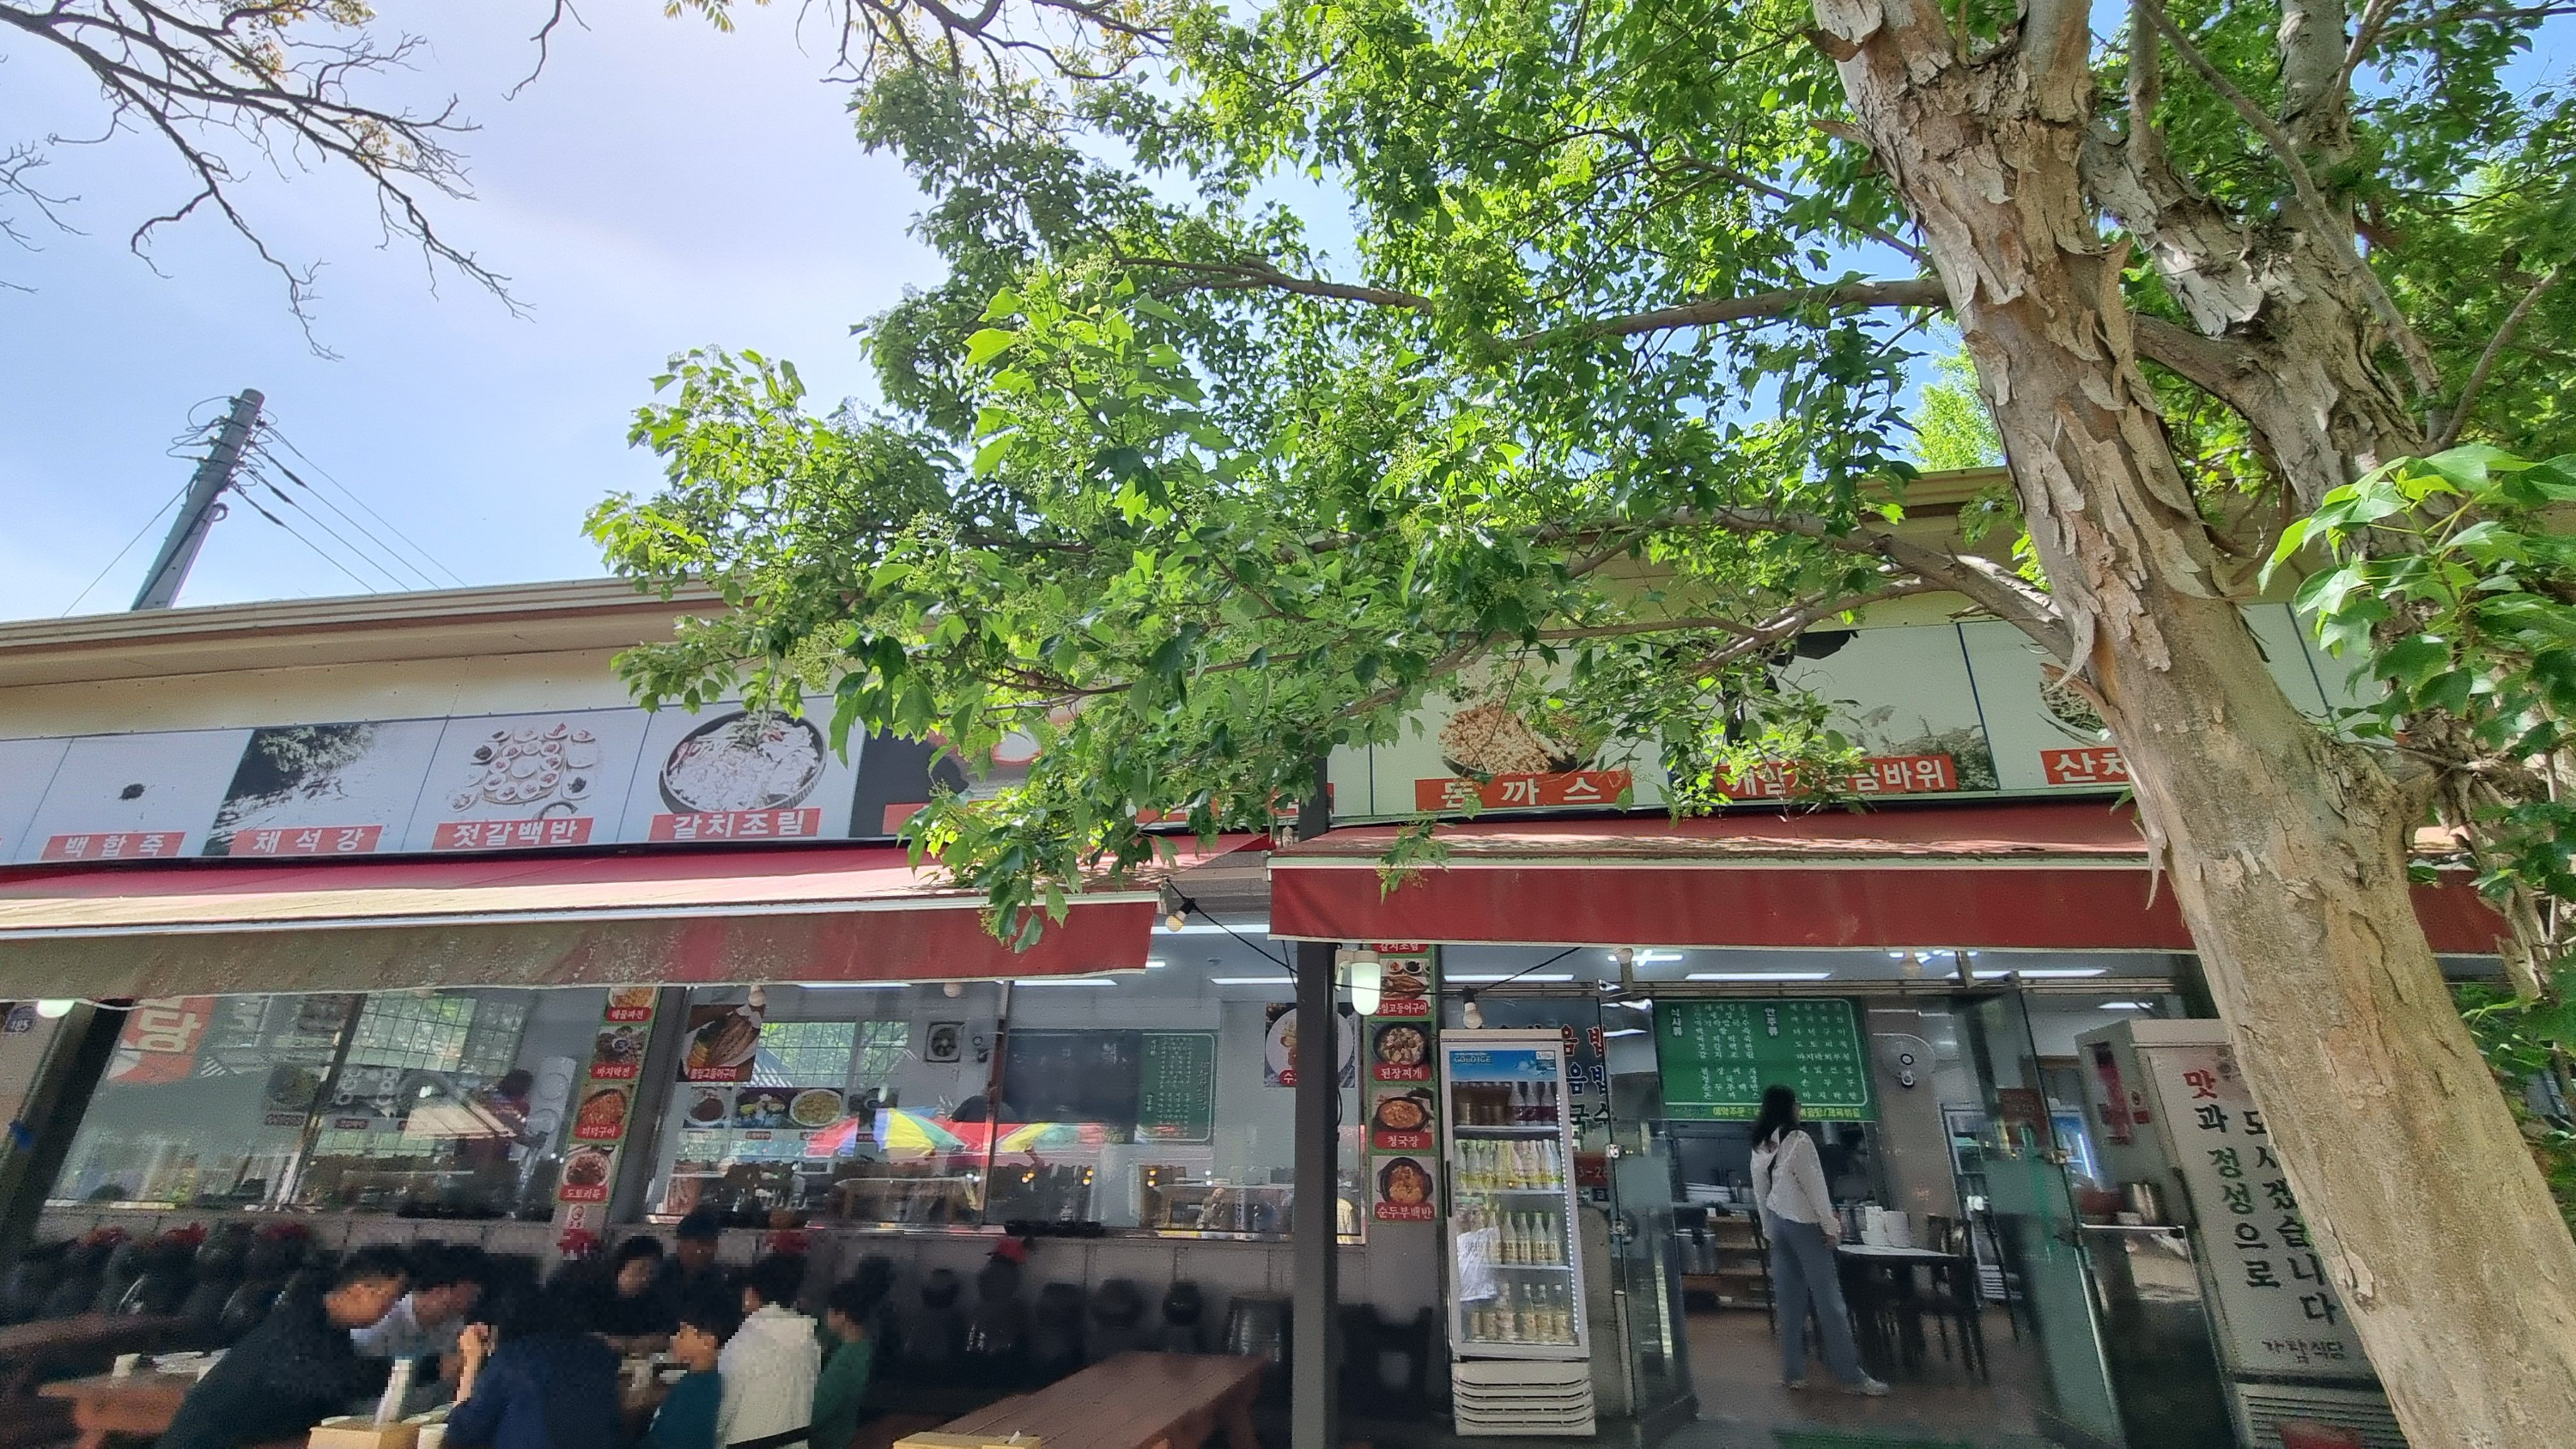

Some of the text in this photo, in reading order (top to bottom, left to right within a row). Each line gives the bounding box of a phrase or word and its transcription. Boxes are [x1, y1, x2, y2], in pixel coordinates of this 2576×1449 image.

[453, 820, 578, 848] 젓갈백반
[672, 812, 807, 840] 갈치조림
[64, 834, 165, 859] 백합죽
[252, 827, 365, 853] 채석강
[1381, 1067, 1423, 1080] 된장찌개
[1386, 1135, 1420, 1148] 청국장
[1376, 1206, 1433, 1220] 순두부백반
